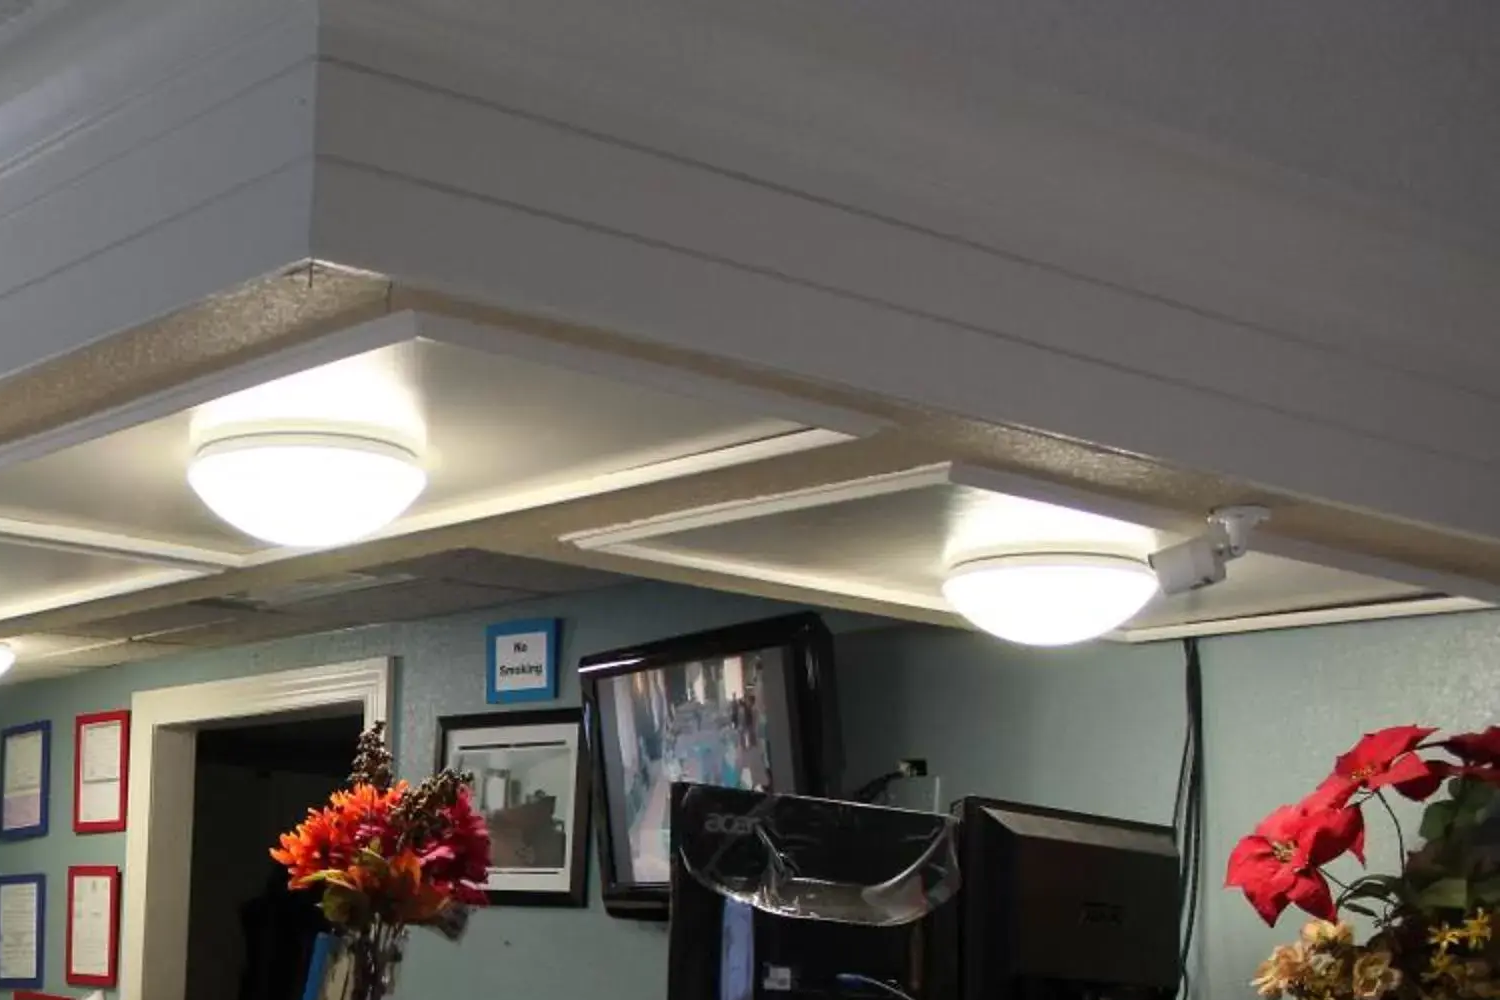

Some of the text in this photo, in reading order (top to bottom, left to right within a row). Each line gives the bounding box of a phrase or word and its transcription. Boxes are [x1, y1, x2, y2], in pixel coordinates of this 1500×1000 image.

[513, 641, 528, 653] No
[499, 664, 543, 677] Smoking
[704, 812, 761, 835] acer
